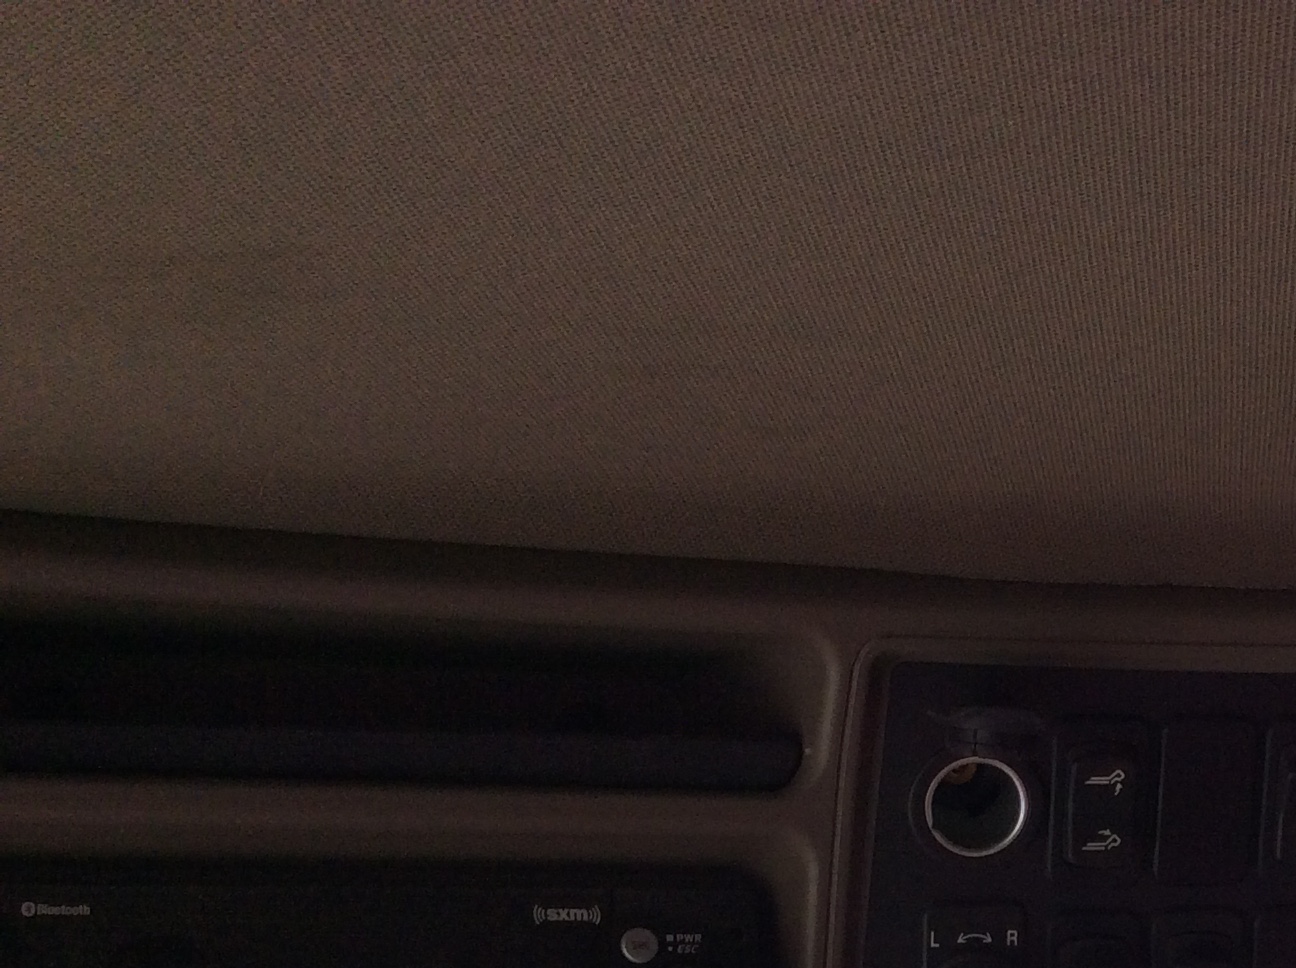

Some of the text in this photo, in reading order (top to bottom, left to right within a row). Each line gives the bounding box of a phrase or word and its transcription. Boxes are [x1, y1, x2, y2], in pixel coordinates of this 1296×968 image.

[37, 903, 91, 916] Bluetooth
[676, 933, 702, 943] PWR
[930, 930, 940, 948] L
[1006, 929, 1018, 946] R
